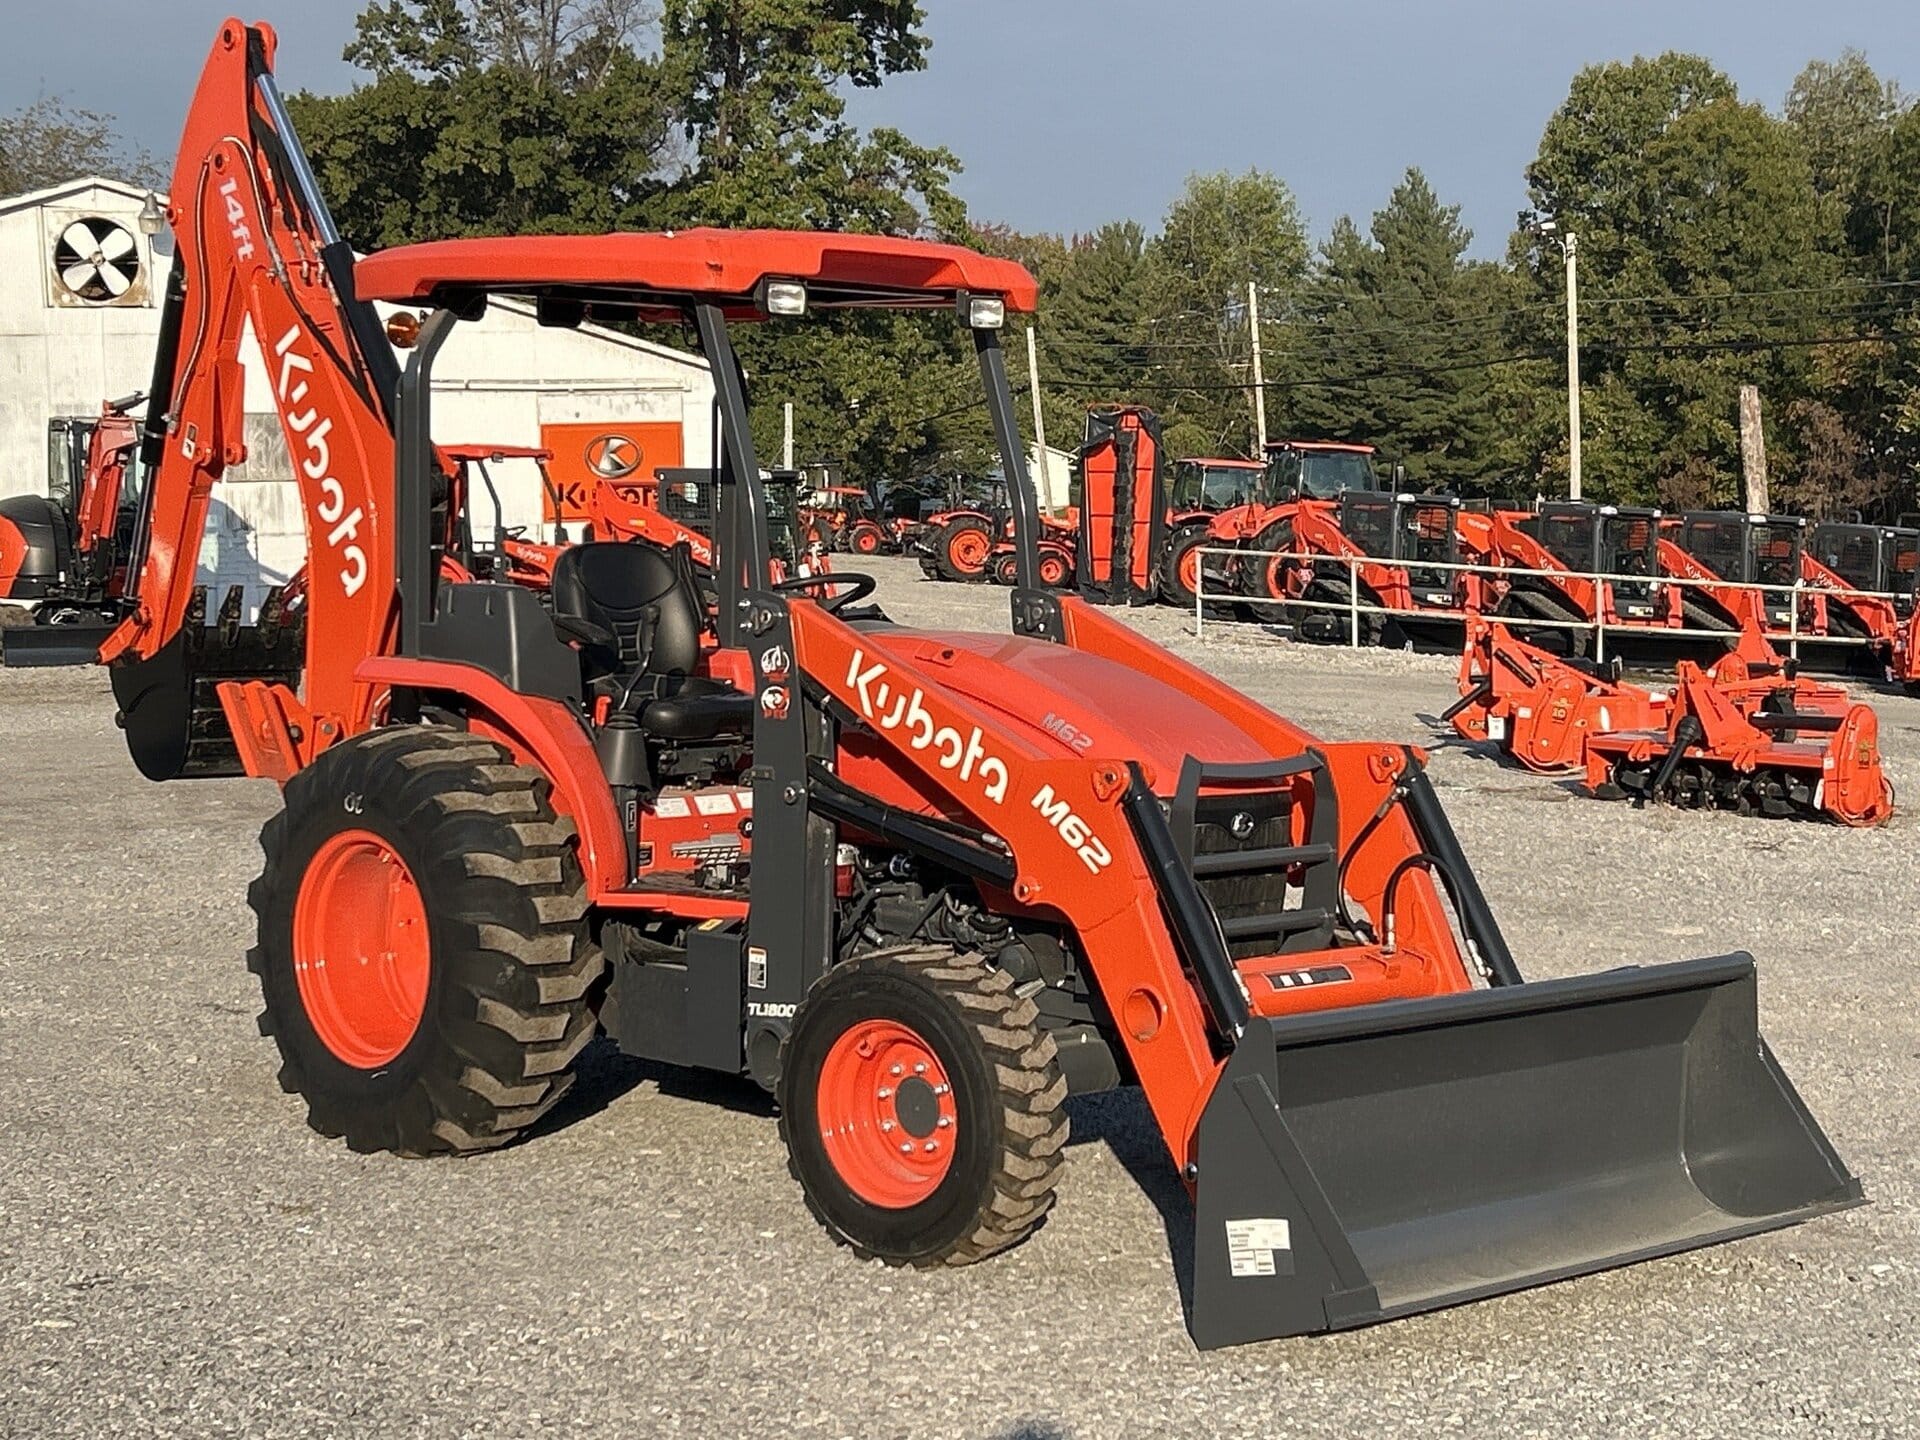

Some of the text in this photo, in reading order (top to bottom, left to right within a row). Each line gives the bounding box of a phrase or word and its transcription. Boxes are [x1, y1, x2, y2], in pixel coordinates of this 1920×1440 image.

[275, 324, 368, 598] Kubota
[846, 649, 1009, 804] Kubota
[1042, 712, 1094, 753] M62
[1031, 784, 1113, 875] M62
[747, 1003, 797, 1018] TL1800
